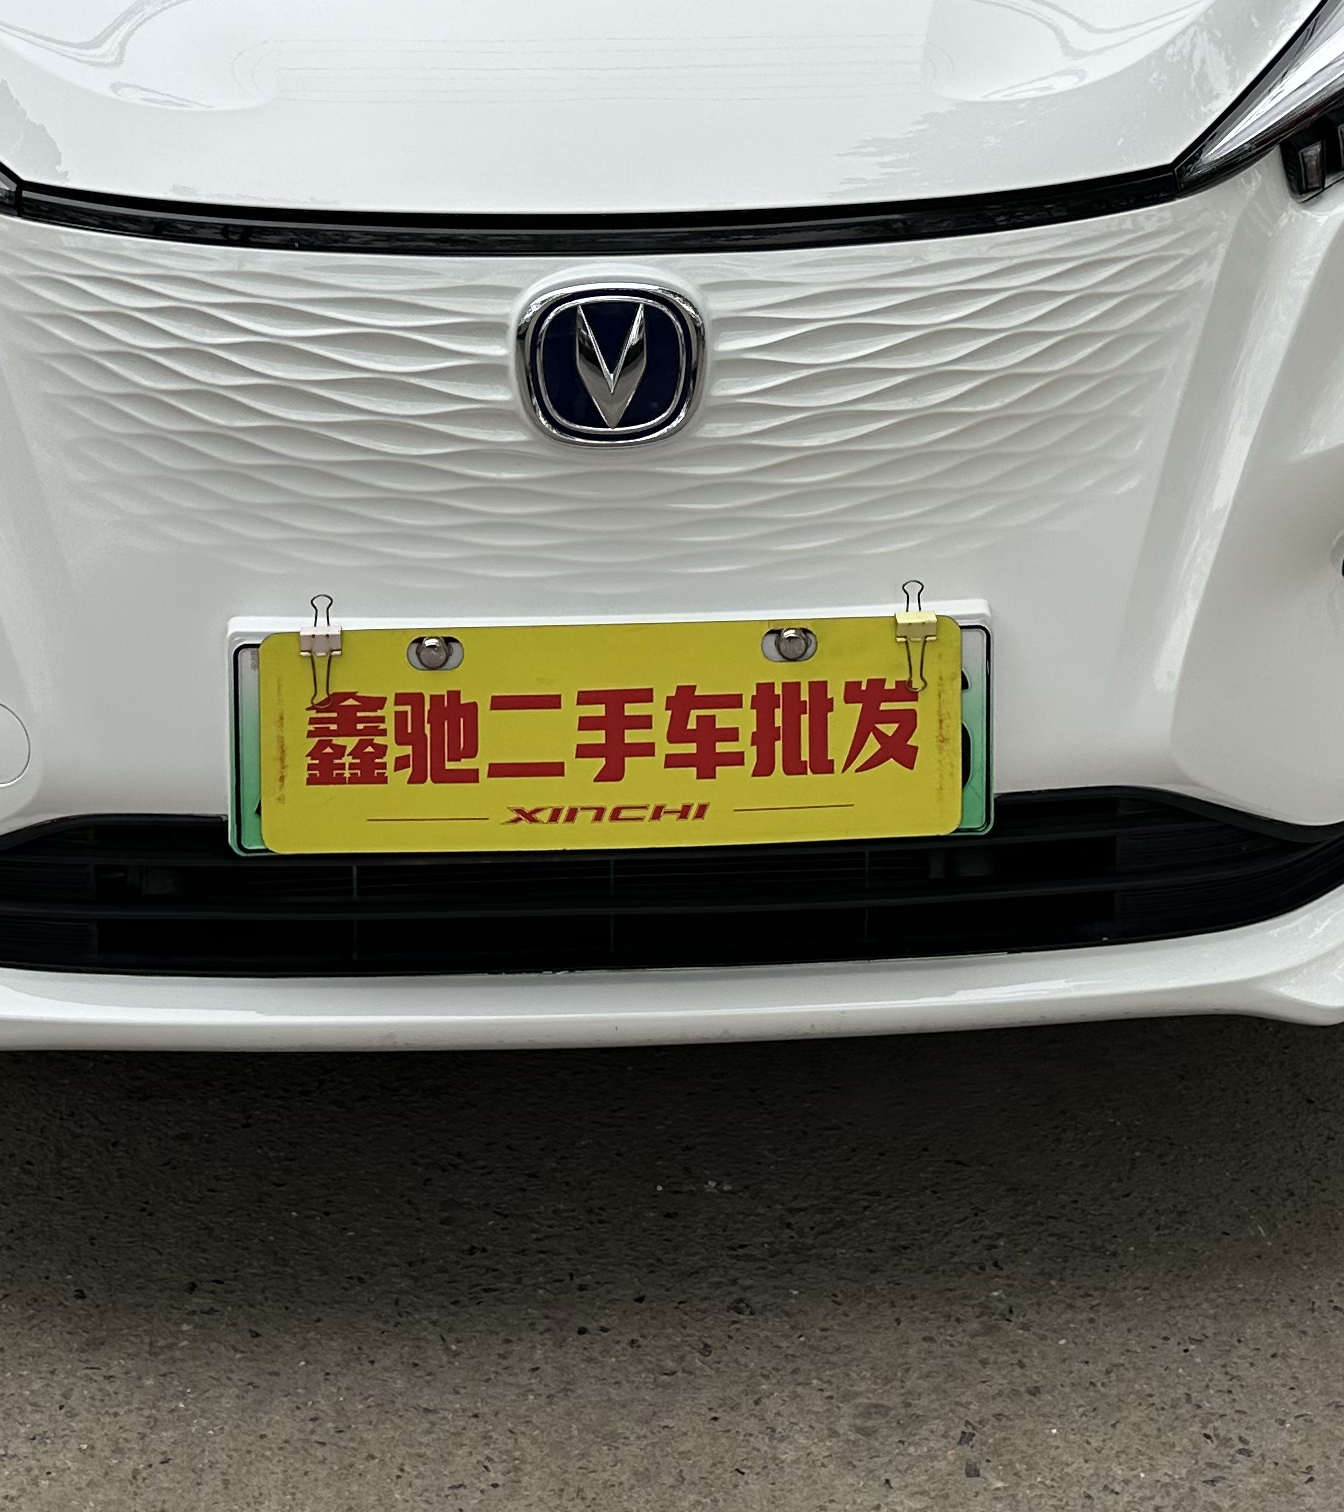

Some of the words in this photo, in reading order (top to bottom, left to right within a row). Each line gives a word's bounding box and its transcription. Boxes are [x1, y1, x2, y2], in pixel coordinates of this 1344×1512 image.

[304, 676, 922, 787] 鑫驰二手车批发
[500, 802, 710, 825] XINCHI
